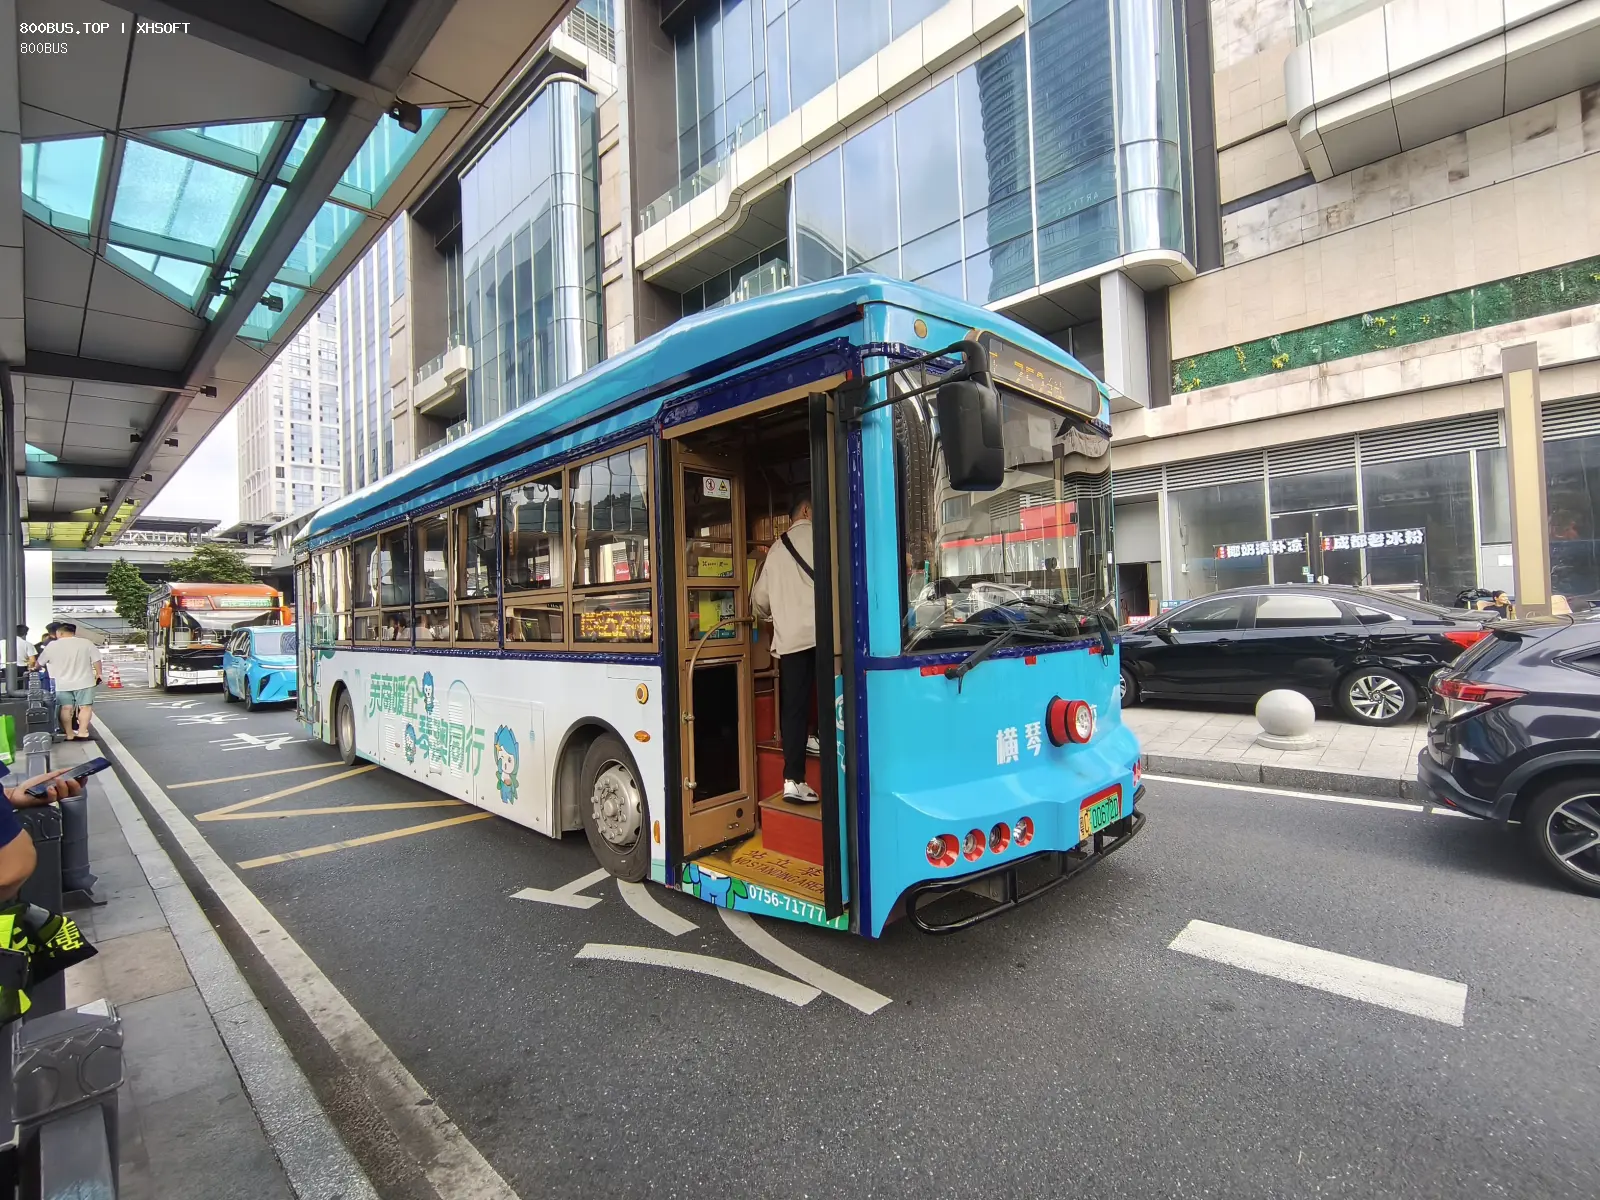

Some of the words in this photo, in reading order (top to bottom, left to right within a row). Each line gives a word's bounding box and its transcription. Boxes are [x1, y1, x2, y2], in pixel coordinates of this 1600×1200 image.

[1226, 539, 1304, 559] 椰奶清补凉
[1333, 529, 1424, 551] 成都老冰粉
[996, 721, 1042, 765] 横琴
[749, 884, 840, 929] 0756-71777
